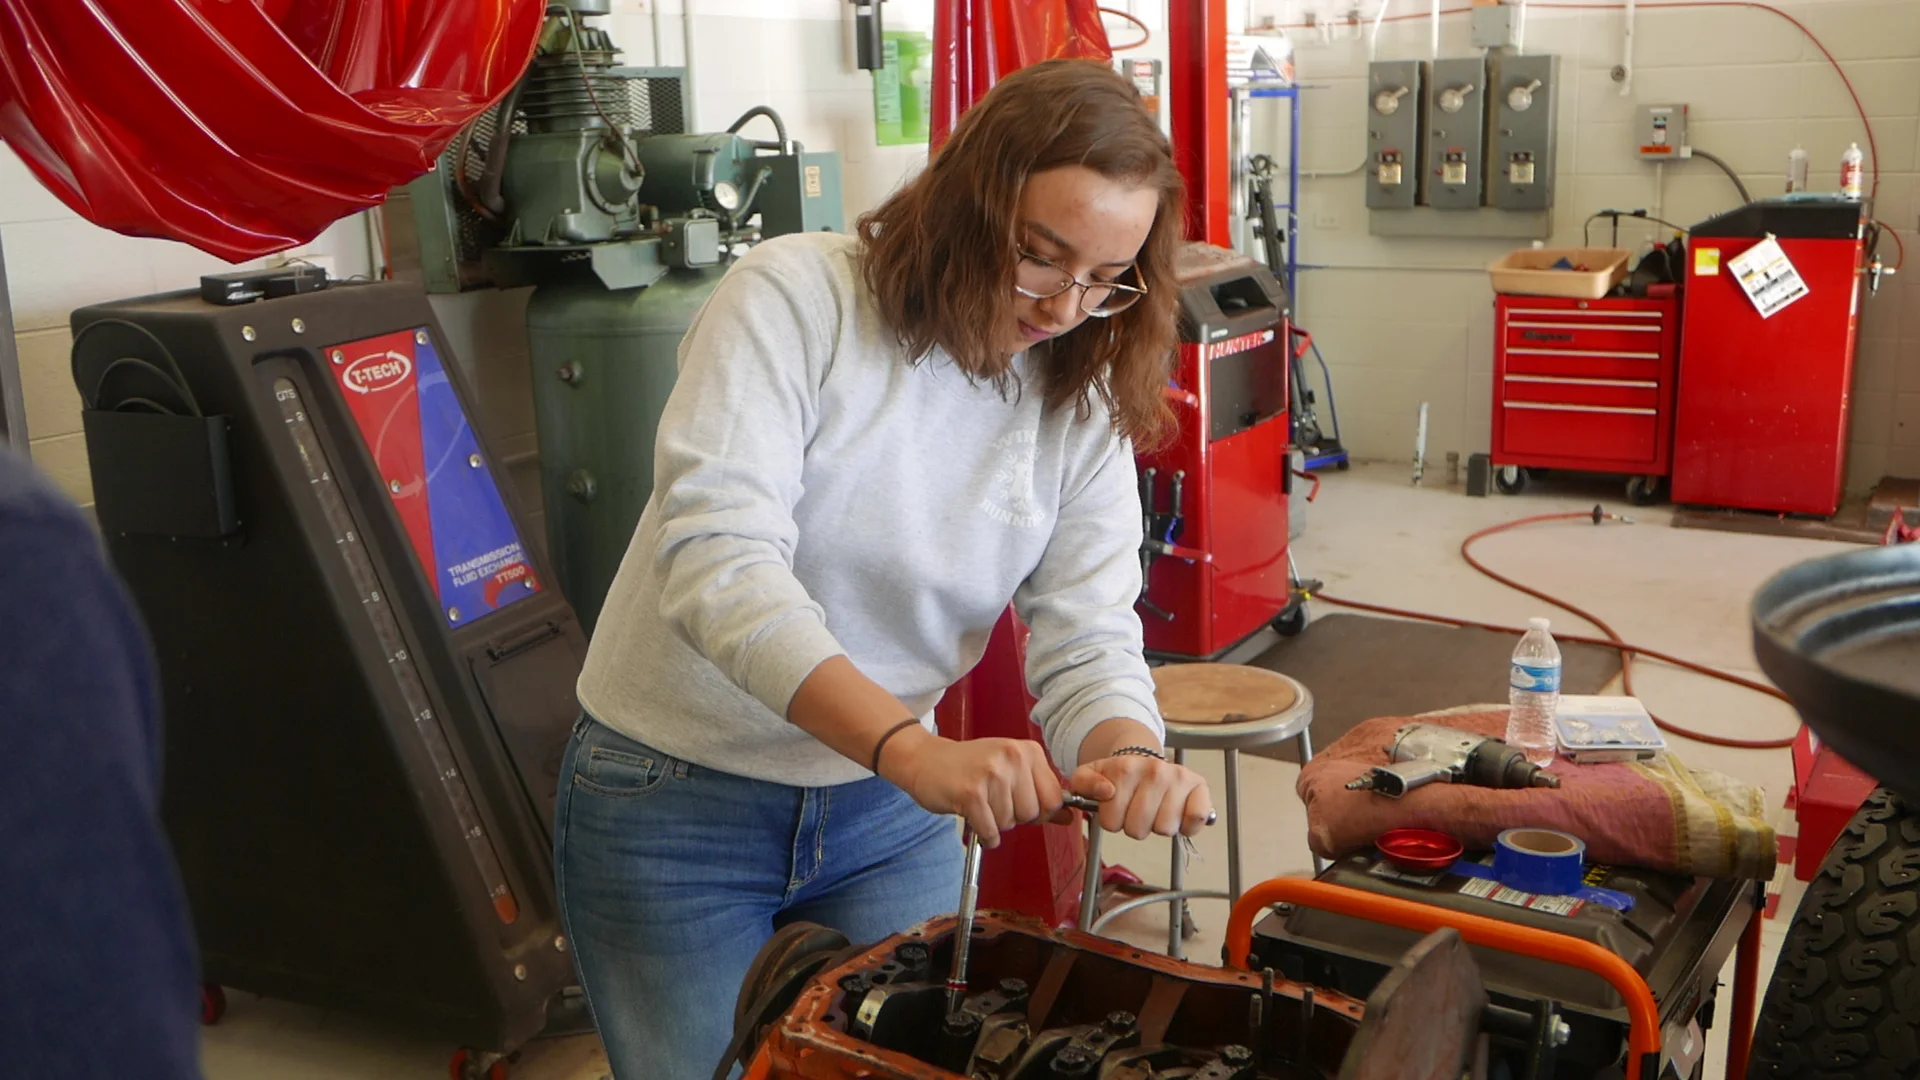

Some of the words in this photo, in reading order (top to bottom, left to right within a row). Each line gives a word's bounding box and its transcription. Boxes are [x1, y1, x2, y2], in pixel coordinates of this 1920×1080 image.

[322, 472, 329, 480] 4
[447, 542, 520, 577] TRANSMISSION
[453, 570, 478, 588] FLUID
[478, 551, 524, 578] EXCHANGE
[495, 564, 525, 584] TT500
[371, 592, 380, 602] 8
[395, 650, 407, 661] 10
[420, 709, 432, 720] 12
[446, 768, 457, 778] 14
[470, 826, 482, 837] 16
